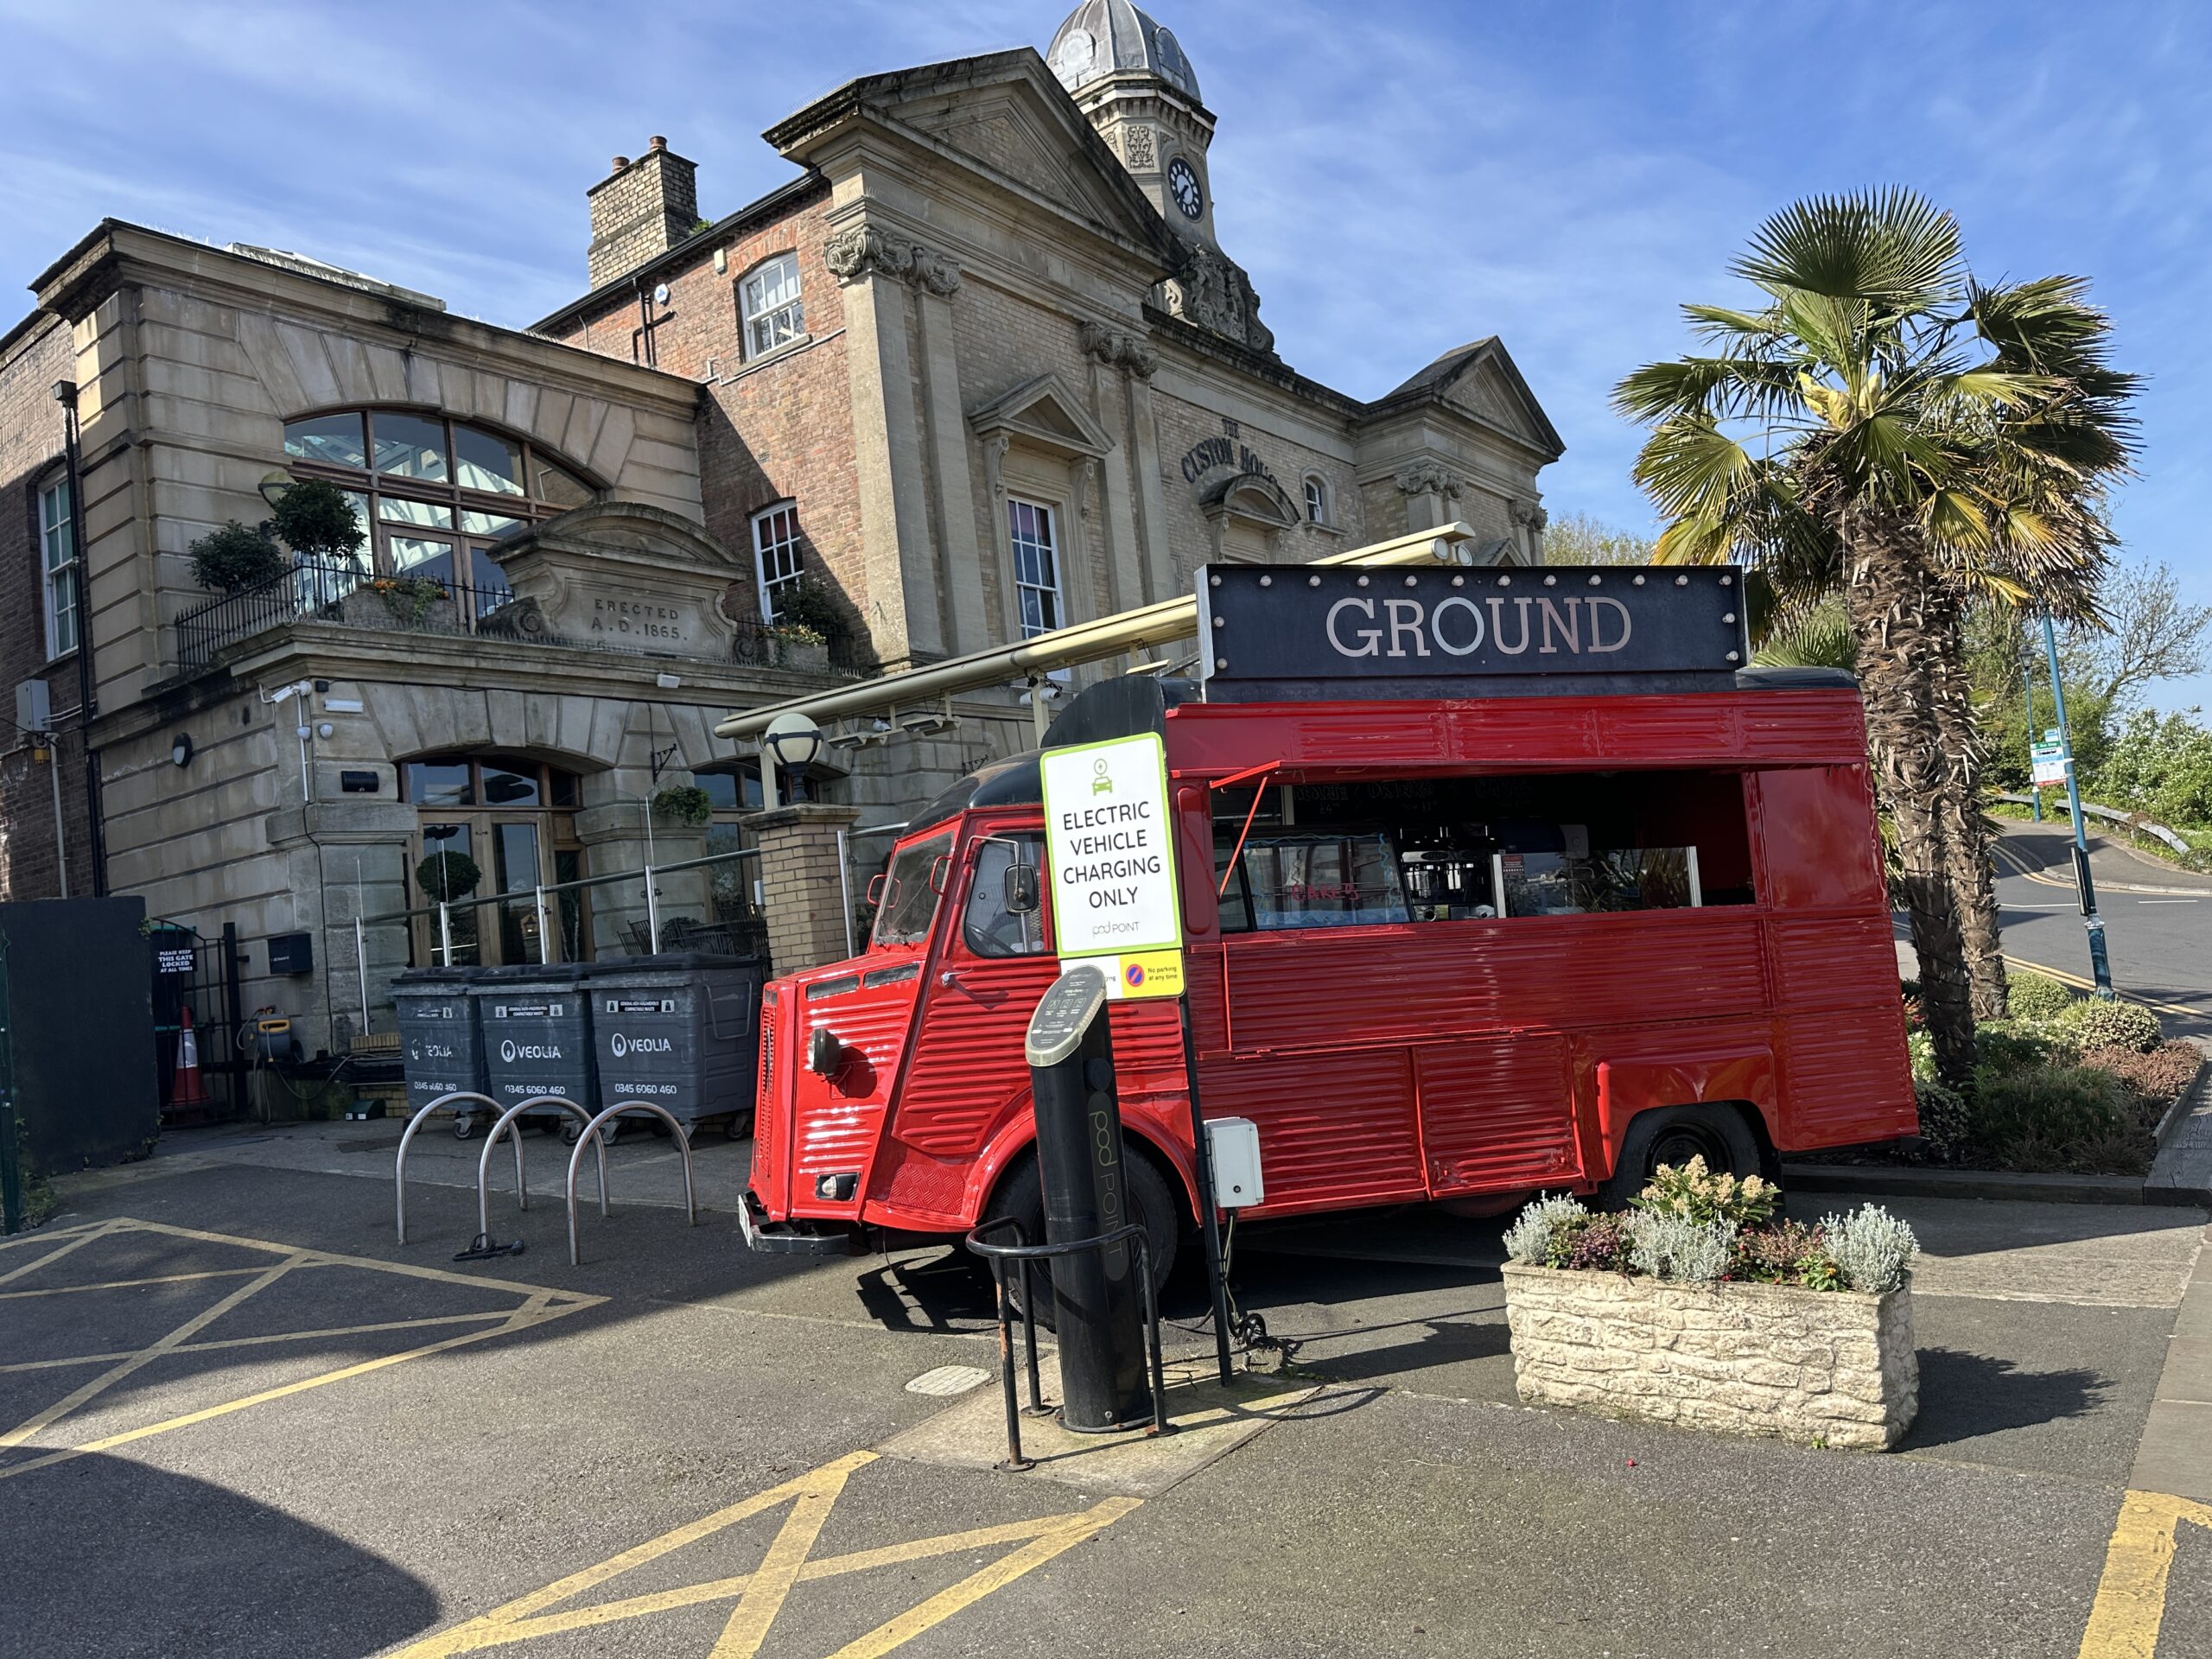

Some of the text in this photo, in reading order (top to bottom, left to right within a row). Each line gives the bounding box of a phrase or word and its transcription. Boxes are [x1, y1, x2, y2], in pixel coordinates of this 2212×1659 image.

[1222, 418, 1240, 440] THE
[1181, 437, 1235, 483] CUSTOM
[594, 599, 678, 620] ERECTED
[1325, 596, 1632, 657] GROUND
[1063, 801, 1151, 831] ELECTRIC
[1070, 830, 1148, 856] VEHICLE
[1063, 856, 1161, 885] CHARGING
[1089, 887, 1139, 909] ONLY
[1092, 921, 1140, 938] pod POINT
[517, 1046, 562, 1058] VEOLIA
[627, 1038, 672, 1052] VEOLIA
[505, 1084, 565, 1095] 0345 6060 460
[614, 1084, 677, 1095] 0345 6060 460
[1089, 1110, 1119, 1166] pod
